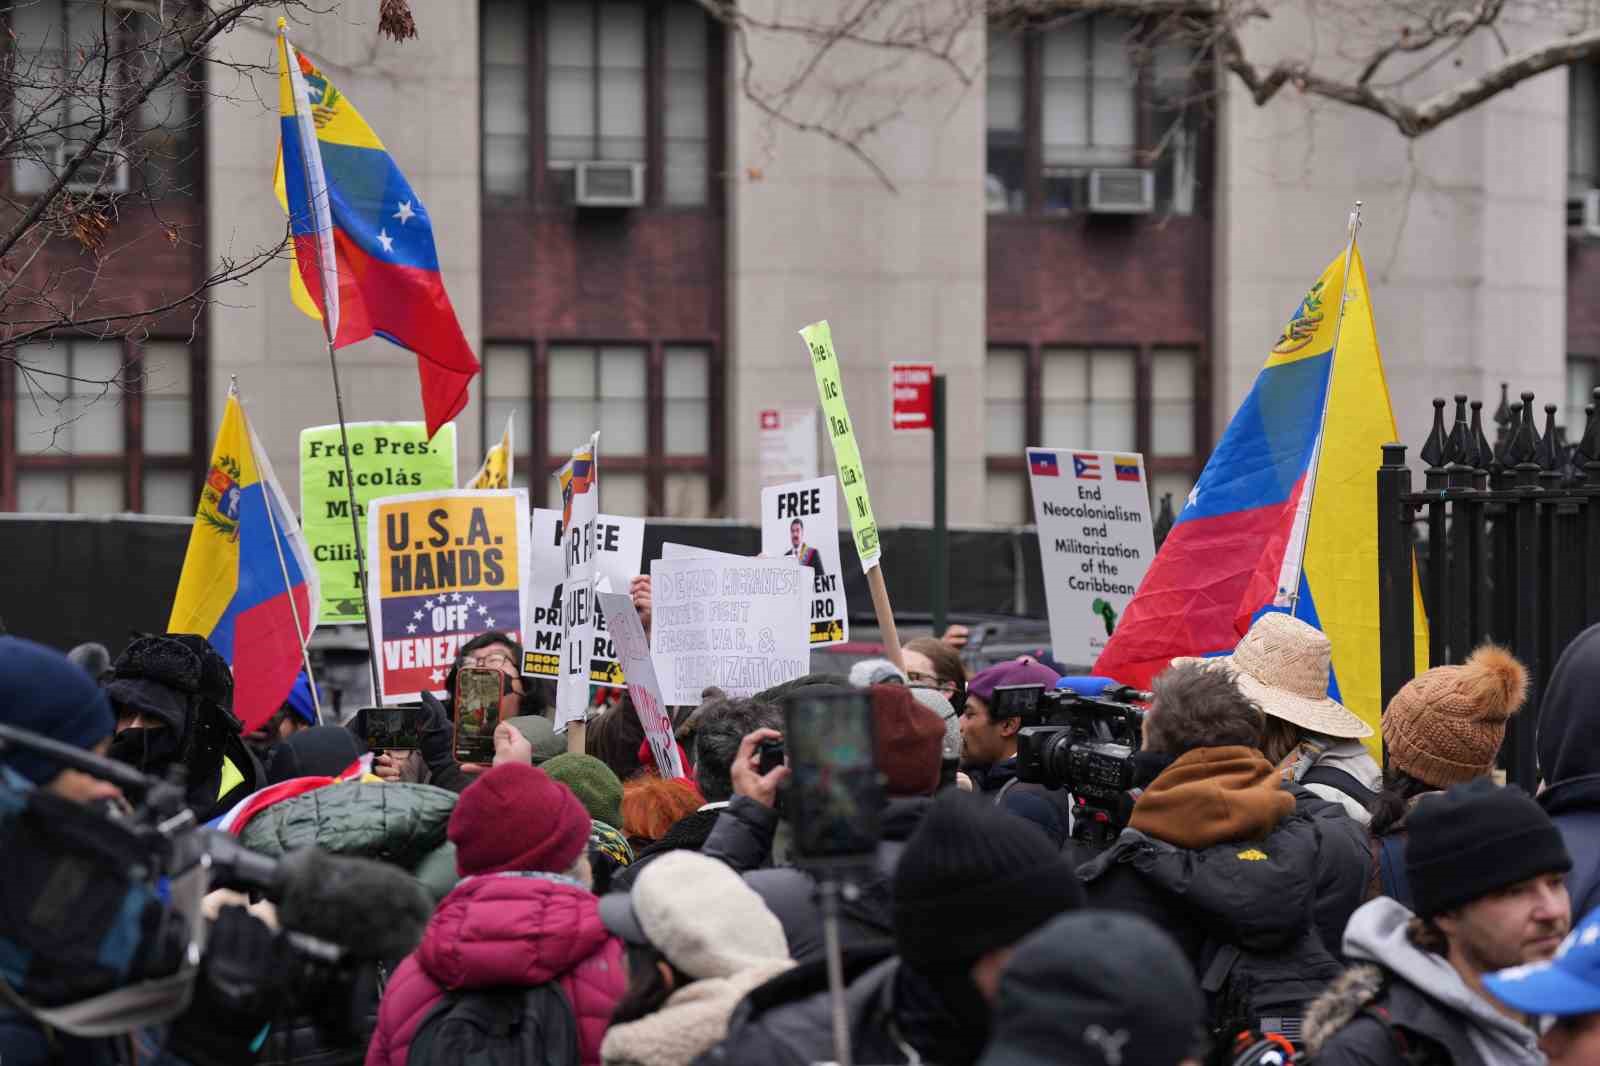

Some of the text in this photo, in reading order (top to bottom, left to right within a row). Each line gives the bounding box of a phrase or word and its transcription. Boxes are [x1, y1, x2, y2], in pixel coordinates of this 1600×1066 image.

[374, 437, 437, 455] Pres.
[777, 489, 820, 519] FREE
[1078, 486, 1101, 501] End
[1043, 501, 1141, 522] Neocolonialism
[387, 507, 503, 550] U.S.A.
[1082, 524, 1107, 538] and
[1055, 539, 1140, 559] Militarization
[391, 548, 505, 592] HANDS
[1081, 559, 1118, 575] of the
[1068, 576, 1136, 595] Caribbean
[432, 605, 470, 632] OFF
[758, 627, 776, 654] &
[384, 632, 479, 671] VENEZ
